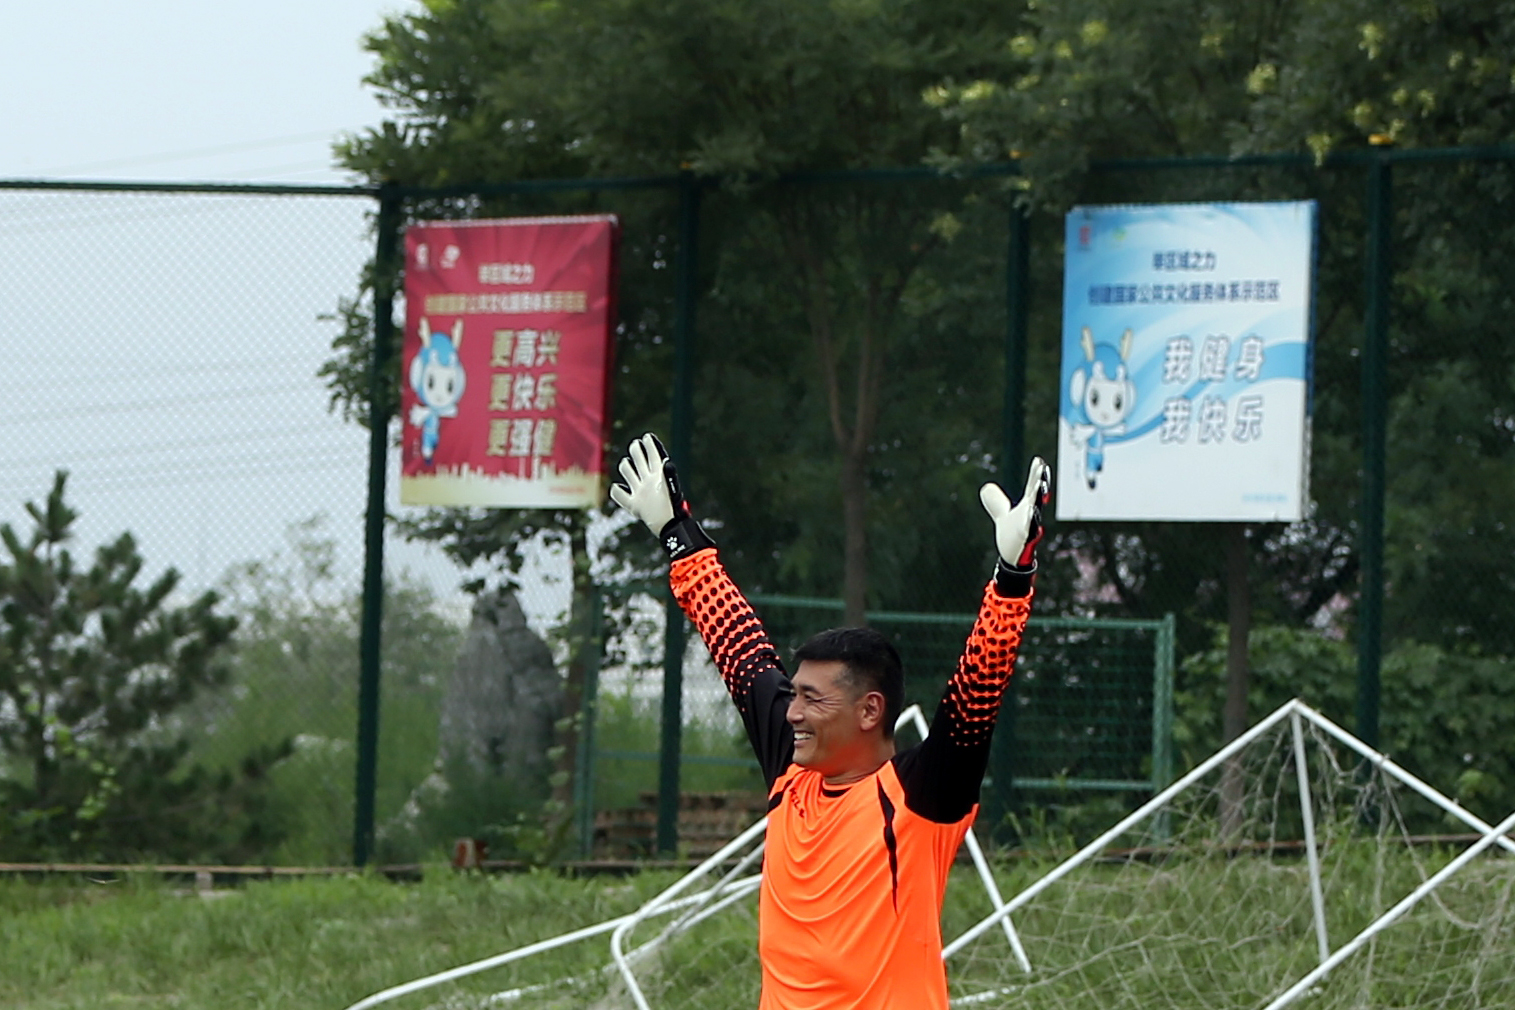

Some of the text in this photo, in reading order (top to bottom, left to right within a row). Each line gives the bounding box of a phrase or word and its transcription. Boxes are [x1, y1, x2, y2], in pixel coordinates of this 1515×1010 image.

[490, 328, 561, 368] 更高兴
[1162, 335, 1266, 384] 我健身
[488, 372, 558, 411] 更快乐
[1160, 395, 1264, 444] 我快乐
